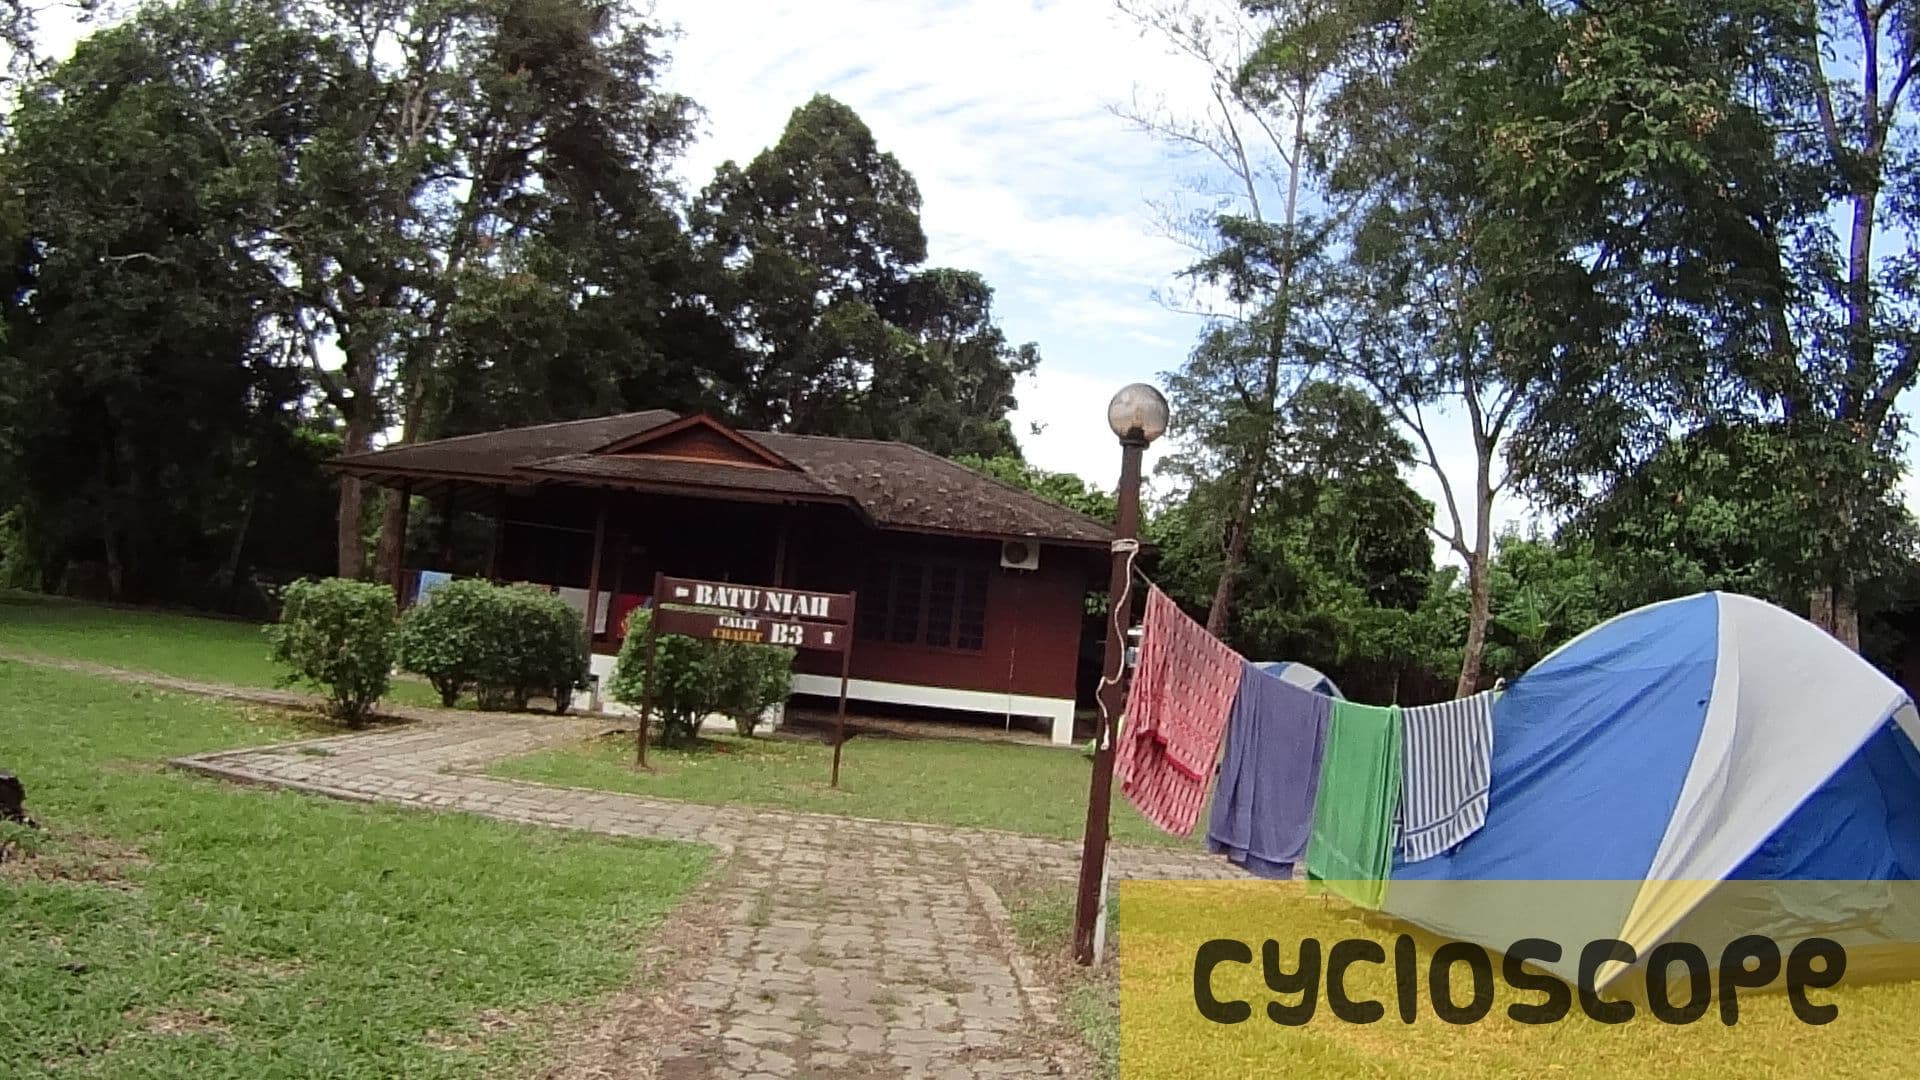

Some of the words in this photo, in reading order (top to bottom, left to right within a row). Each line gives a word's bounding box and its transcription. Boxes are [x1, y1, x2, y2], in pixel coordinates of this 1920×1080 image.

[695, 584, 760, 609] BATU
[765, 591, 829, 617] NIAH
[719, 616, 759, 630] CALET
[713, 628, 763, 643] CHALET
[770, 623, 804, 645] B3
